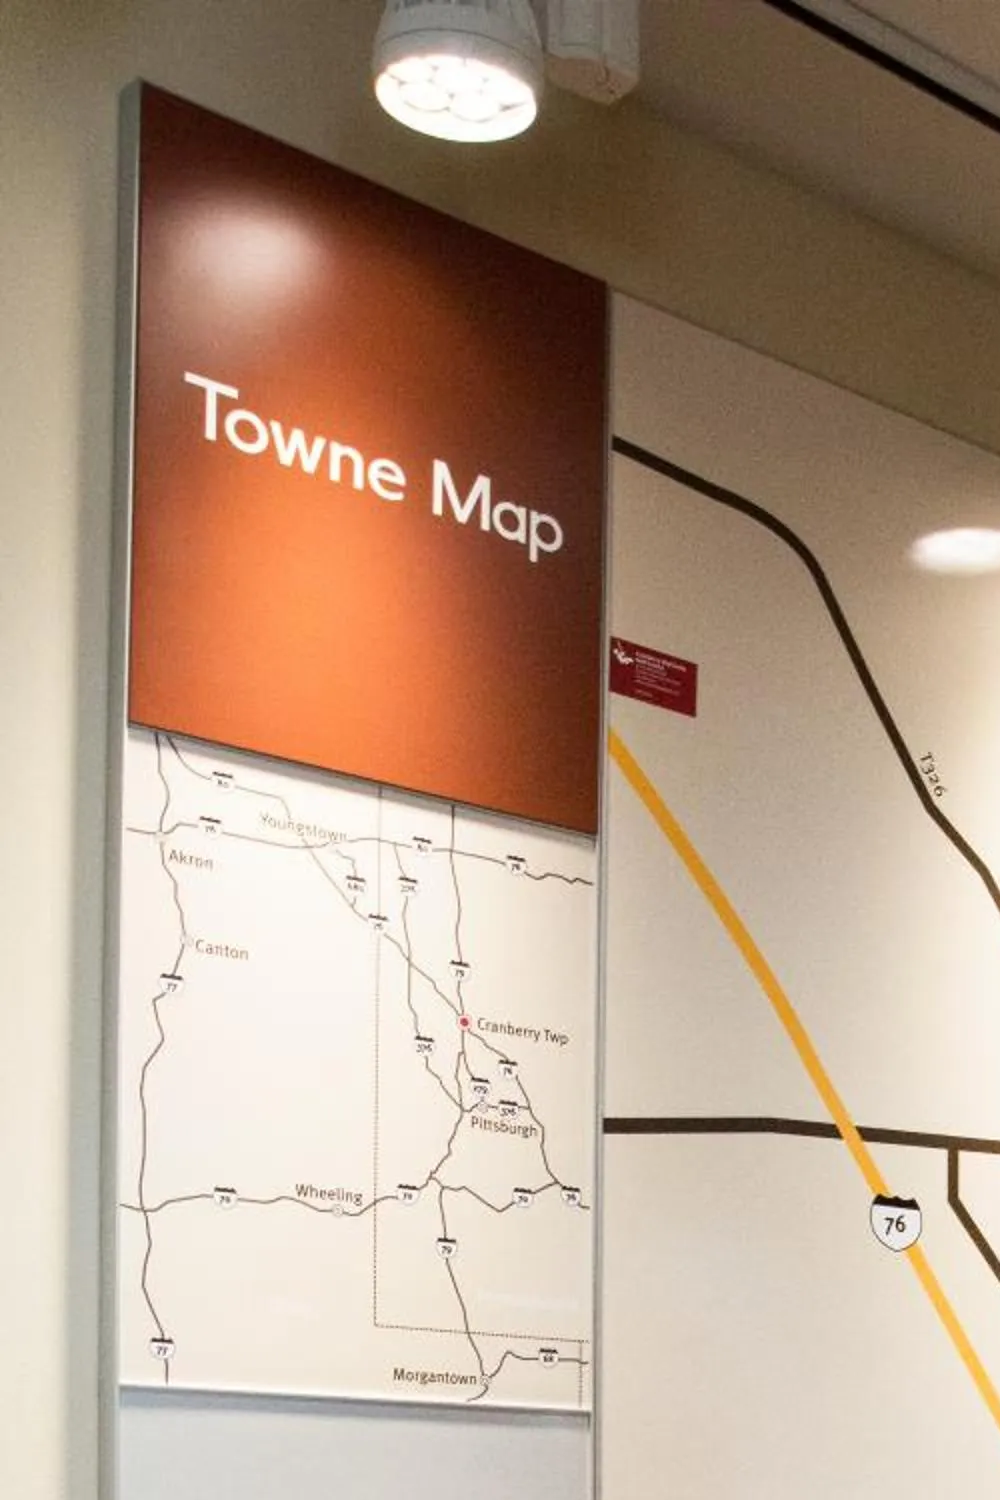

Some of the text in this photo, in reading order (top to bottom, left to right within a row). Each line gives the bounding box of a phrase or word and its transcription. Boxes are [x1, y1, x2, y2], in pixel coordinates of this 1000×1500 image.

[184, 372, 563, 563] Towne Map
[920, 752, 947, 797] T326
[260, 811, 348, 841] Youngstown
[168, 850, 214, 871] Akron
[194, 939, 250, 962] Canton
[477, 1017, 570, 1046] Cranberry Twp
[471, 1115, 539, 1139] Pittsburgh
[295, 1182, 364, 1207] Wheeling
[883, 1214, 906, 1236] 76
[393, 1367, 477, 1386] Morgantown
